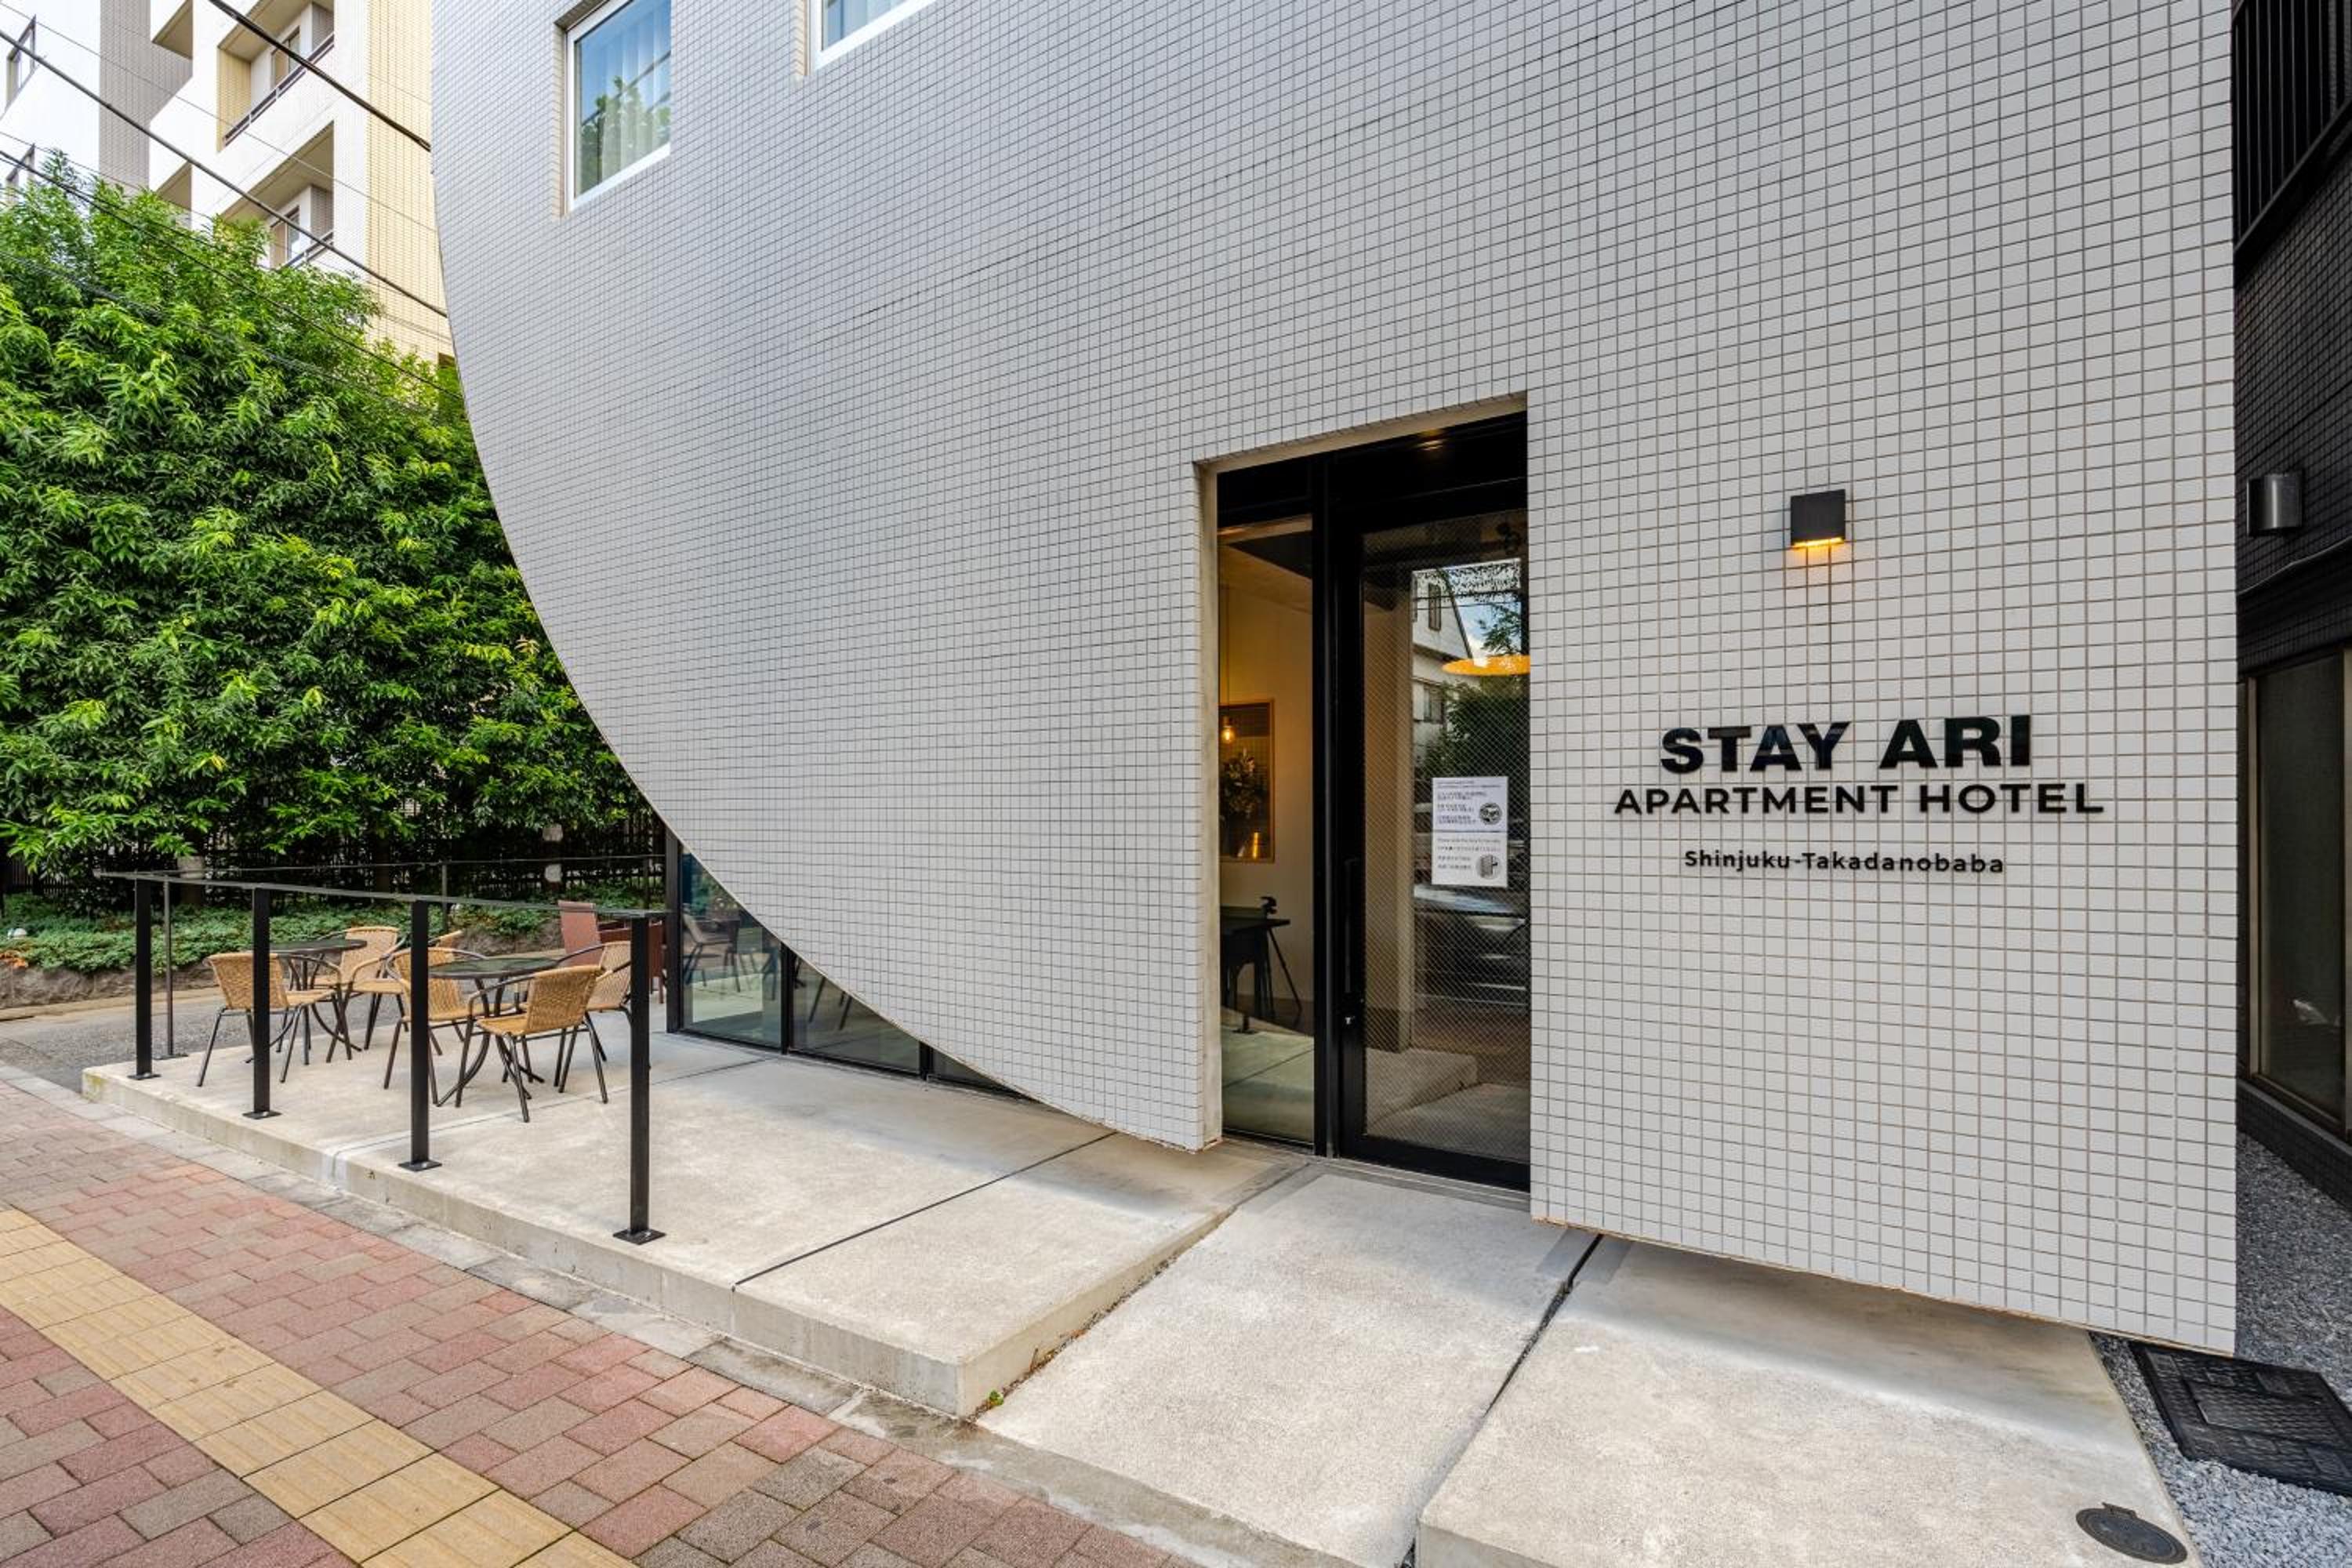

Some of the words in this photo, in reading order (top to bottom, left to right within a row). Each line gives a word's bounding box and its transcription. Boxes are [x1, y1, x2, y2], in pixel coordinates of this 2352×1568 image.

[1660, 720, 1851, 775] STAY
[1877, 714, 2031, 770] ARI
[1614, 784, 1899, 816] APARTMENT
[1918, 782, 2104, 815] HOTEL
[1685, 849, 2003, 873] Shinjuku-Takadanobaba
